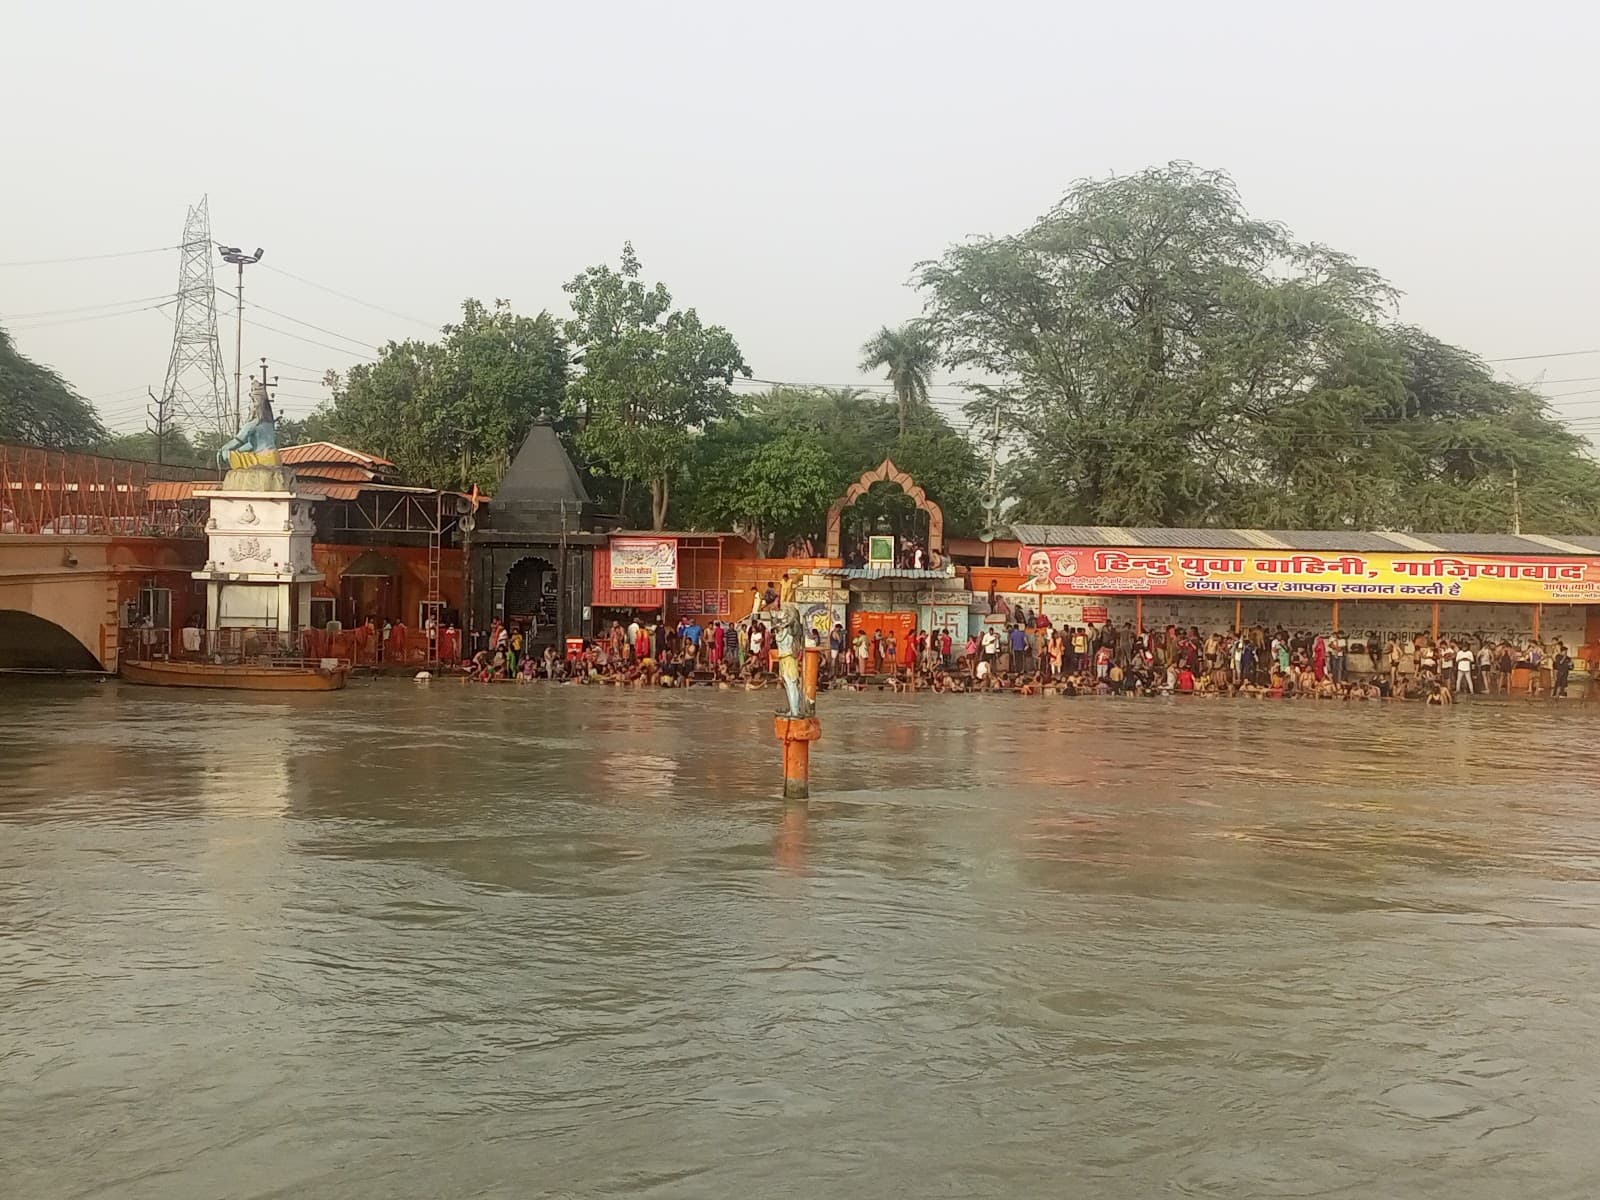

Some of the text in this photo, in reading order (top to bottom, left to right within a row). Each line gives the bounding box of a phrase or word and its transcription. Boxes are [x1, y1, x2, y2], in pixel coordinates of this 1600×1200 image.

[1179, 556, 1244, 576] युवा
[1255, 556, 1378, 578] वाहिनी,
[1392, 559, 1587, 580] गाज़ियाबाद
[1186, 578, 1461, 595] गंगा घाट पर आपका स्वागत करती है
